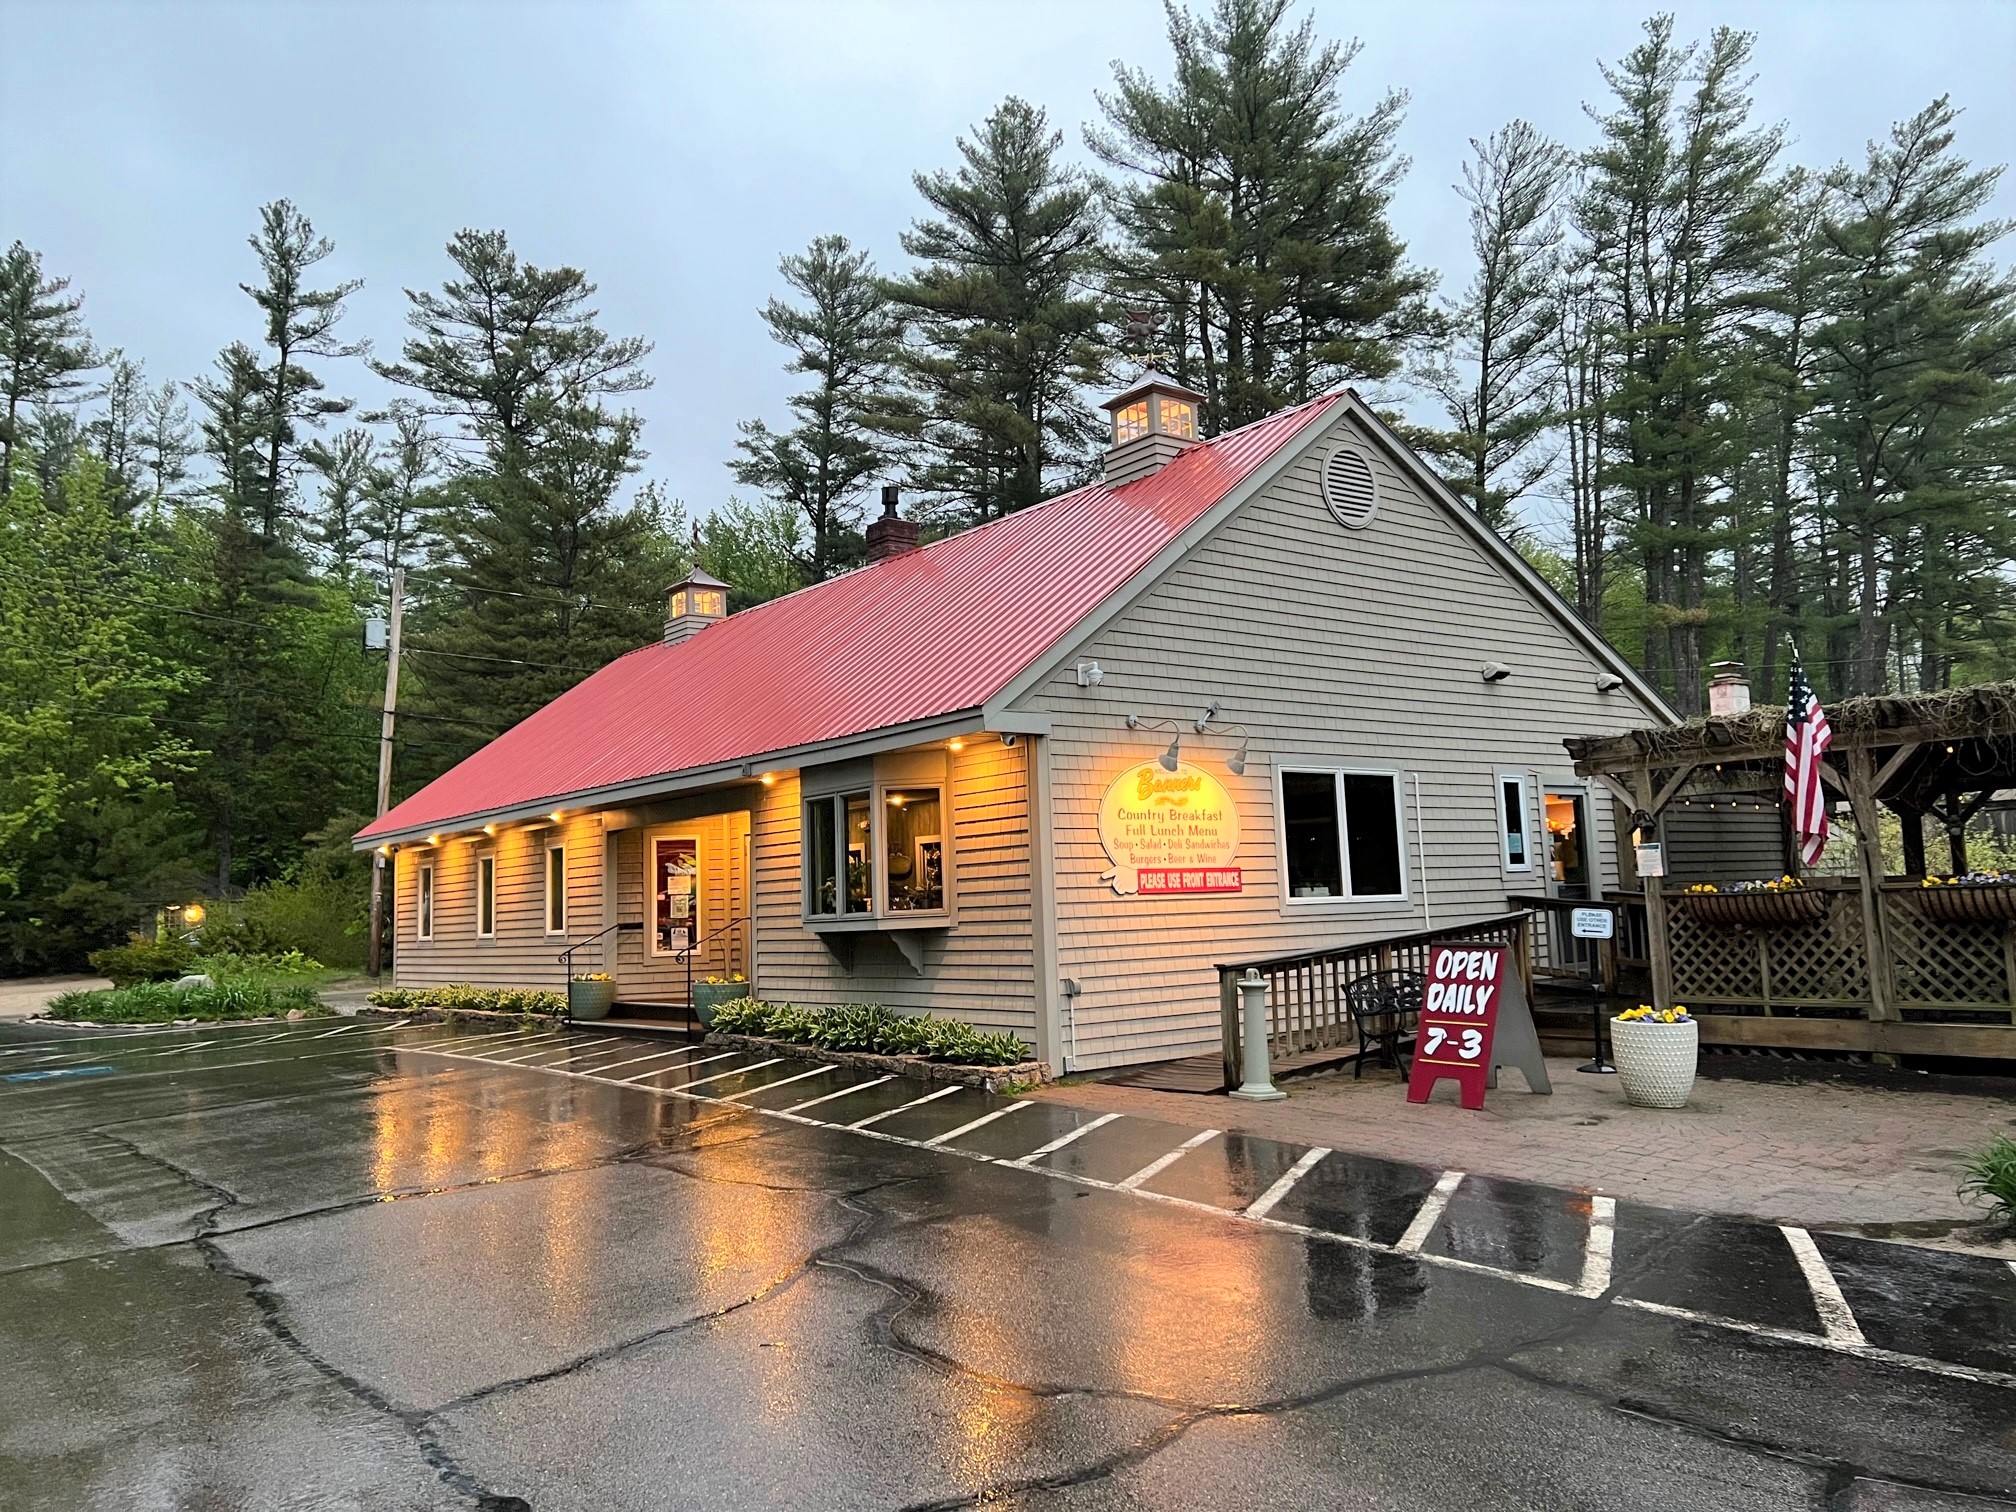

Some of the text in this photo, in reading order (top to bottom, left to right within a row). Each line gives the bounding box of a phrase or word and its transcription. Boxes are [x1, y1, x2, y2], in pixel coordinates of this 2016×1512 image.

[1137, 767, 1201, 800] Banners
[1118, 808, 1222, 822] Country Breakfast
[1126, 825, 1217, 836] Full Lunch Menu
[1114, 838, 1230, 851] Soup Salad Deli Sandwiches
[1130, 854, 1161, 865] Burgers
[1168, 854, 1185, 864] Beer
[1197, 854, 1216, 863] Wine
[1140, 871, 1239, 889] PLEASE USE FRONT ENTRANCE
[1435, 949, 1499, 981] OPEN
[1427, 983, 1495, 1016] DAILY
[1424, 1027, 1483, 1059] 7-3
